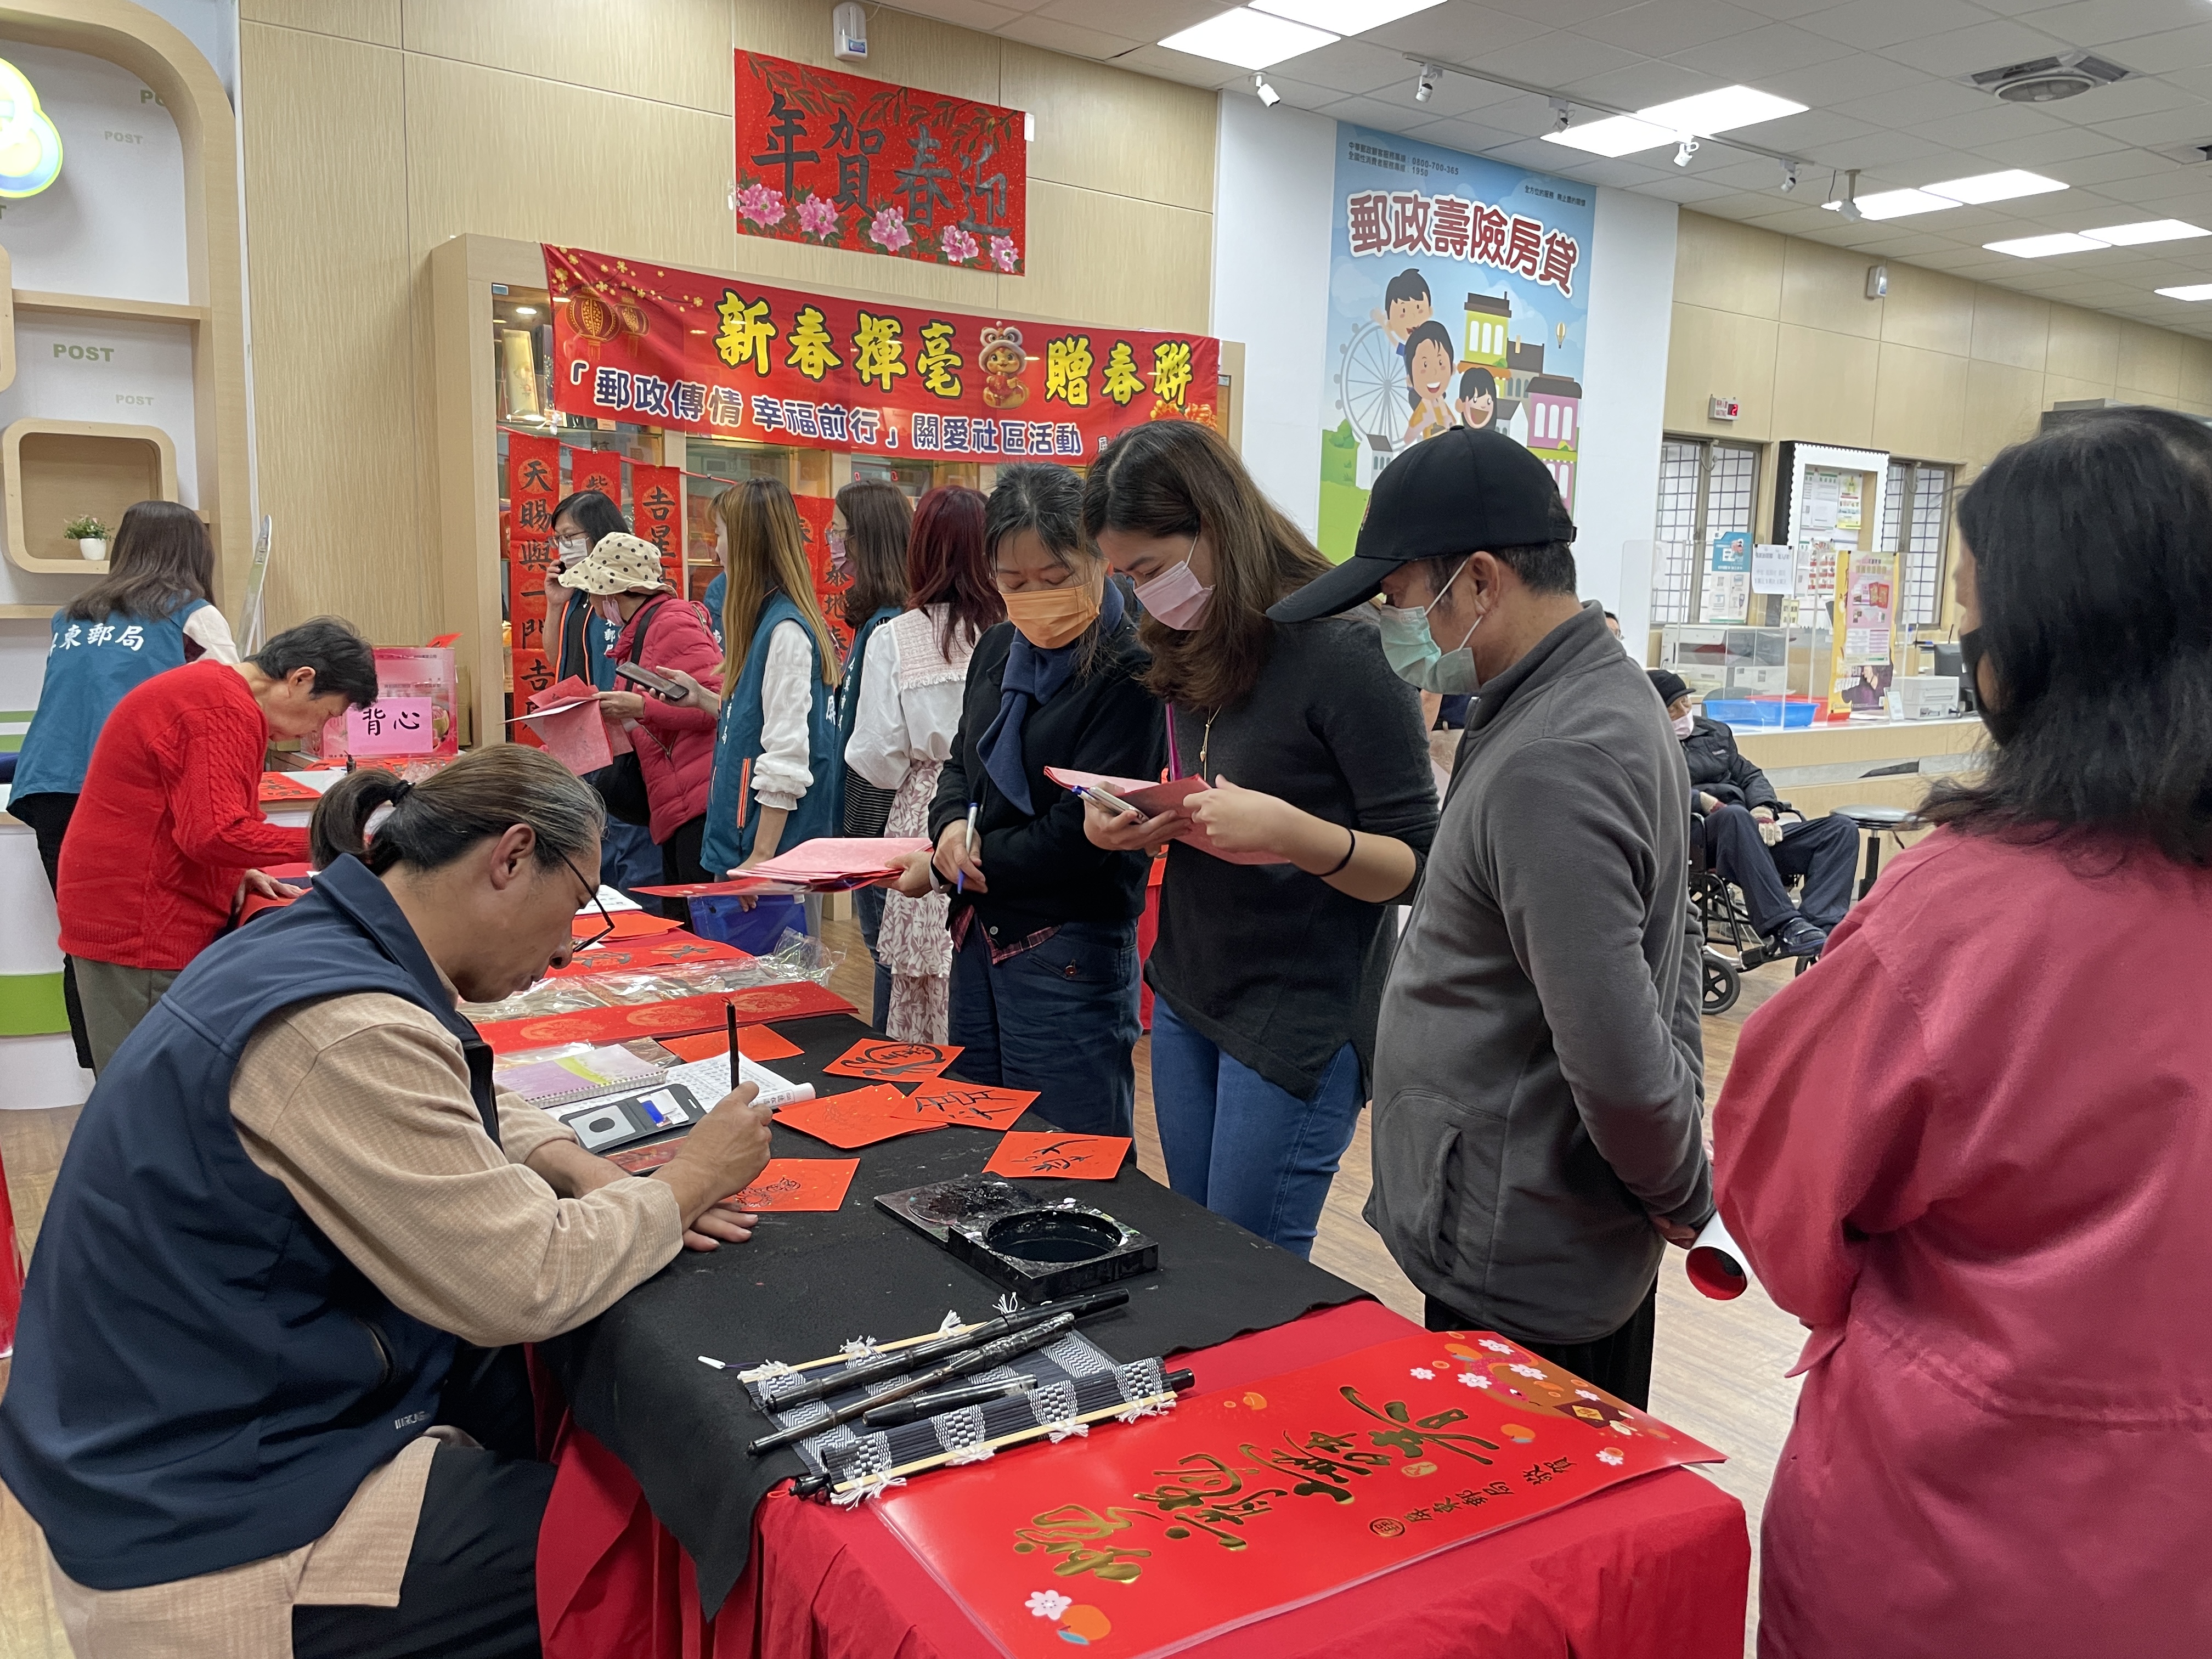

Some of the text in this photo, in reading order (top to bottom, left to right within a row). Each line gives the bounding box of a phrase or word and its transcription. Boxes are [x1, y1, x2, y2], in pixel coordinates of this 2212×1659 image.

[104, 131, 143, 145] POST
[1412, 166, 1429, 177] 1950
[1347, 190, 1579, 297] 郵政壽險房貸
[53, 343, 115, 362] POST
[713, 289, 1193, 408] 新春揮毫 贈春聯
[115, 394, 155, 407] POST
[1731, 404, 1737, 415] 2
[912, 412, 1084, 457] 關愛社區活動
[49, 622, 145, 652] 東郵局
[362, 708, 420, 736] 背心
[1403, 1481, 1515, 1522] 屏東郵局
